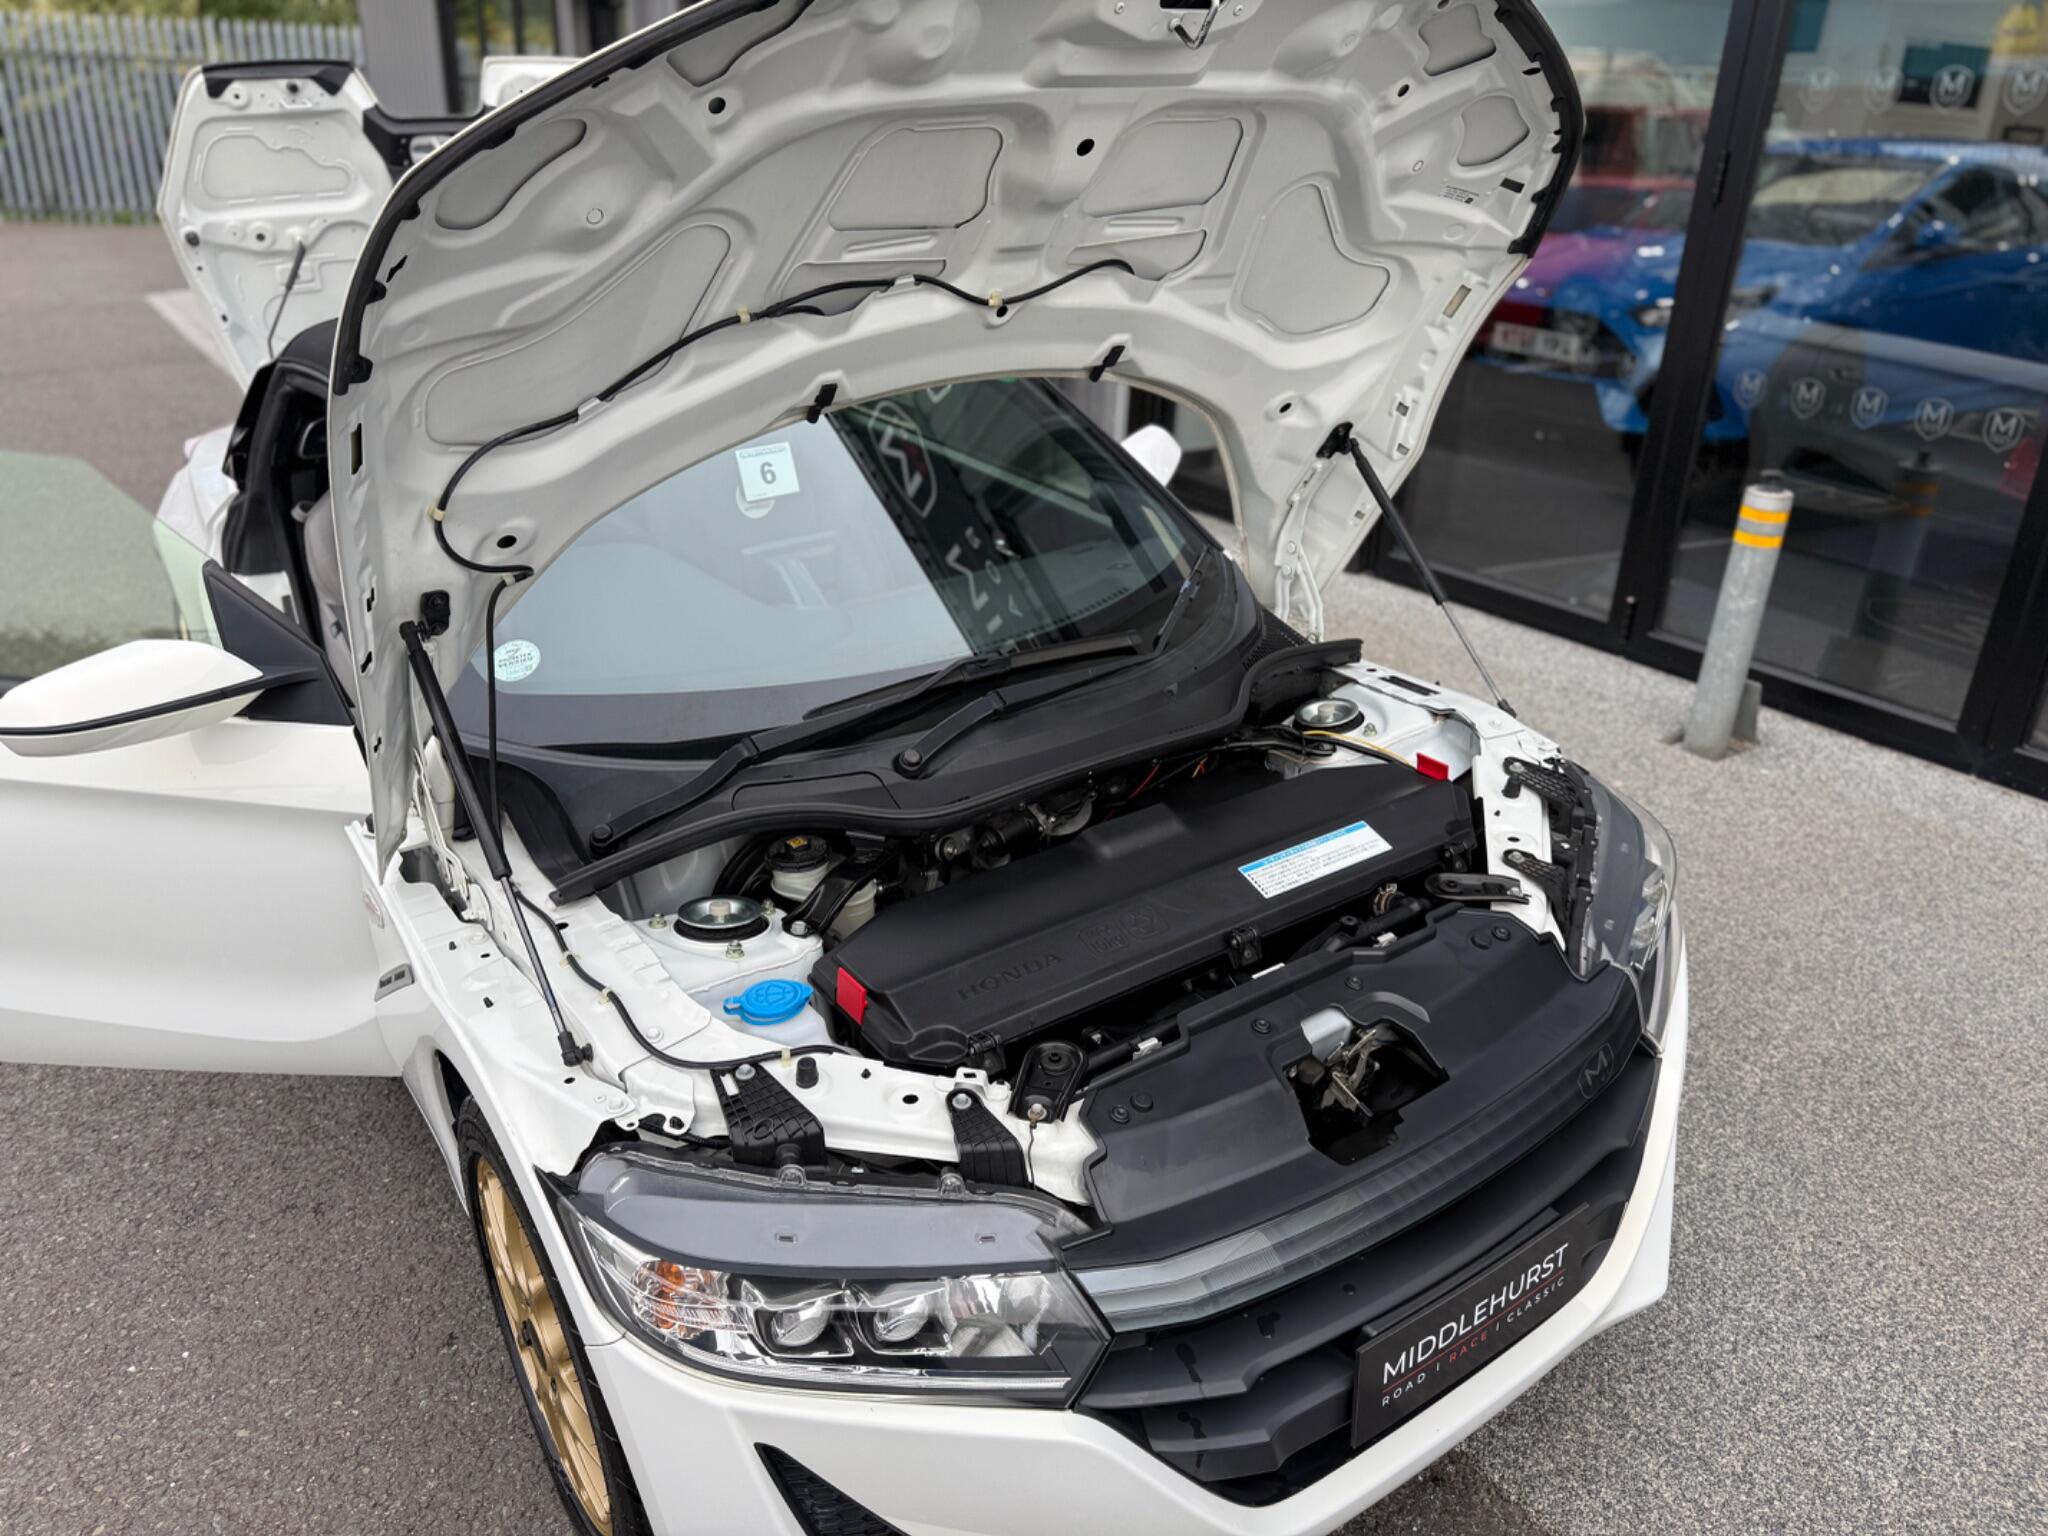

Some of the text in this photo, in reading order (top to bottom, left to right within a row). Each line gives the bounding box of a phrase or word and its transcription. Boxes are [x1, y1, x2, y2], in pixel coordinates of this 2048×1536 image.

[761, 461, 777, 485] 6
[956, 952, 1062, 1001] HONDA
[1382, 1276, 1565, 1407] ROAD RACE CLASSIC
[1383, 1243, 1569, 1385] MIDDLEHURST
